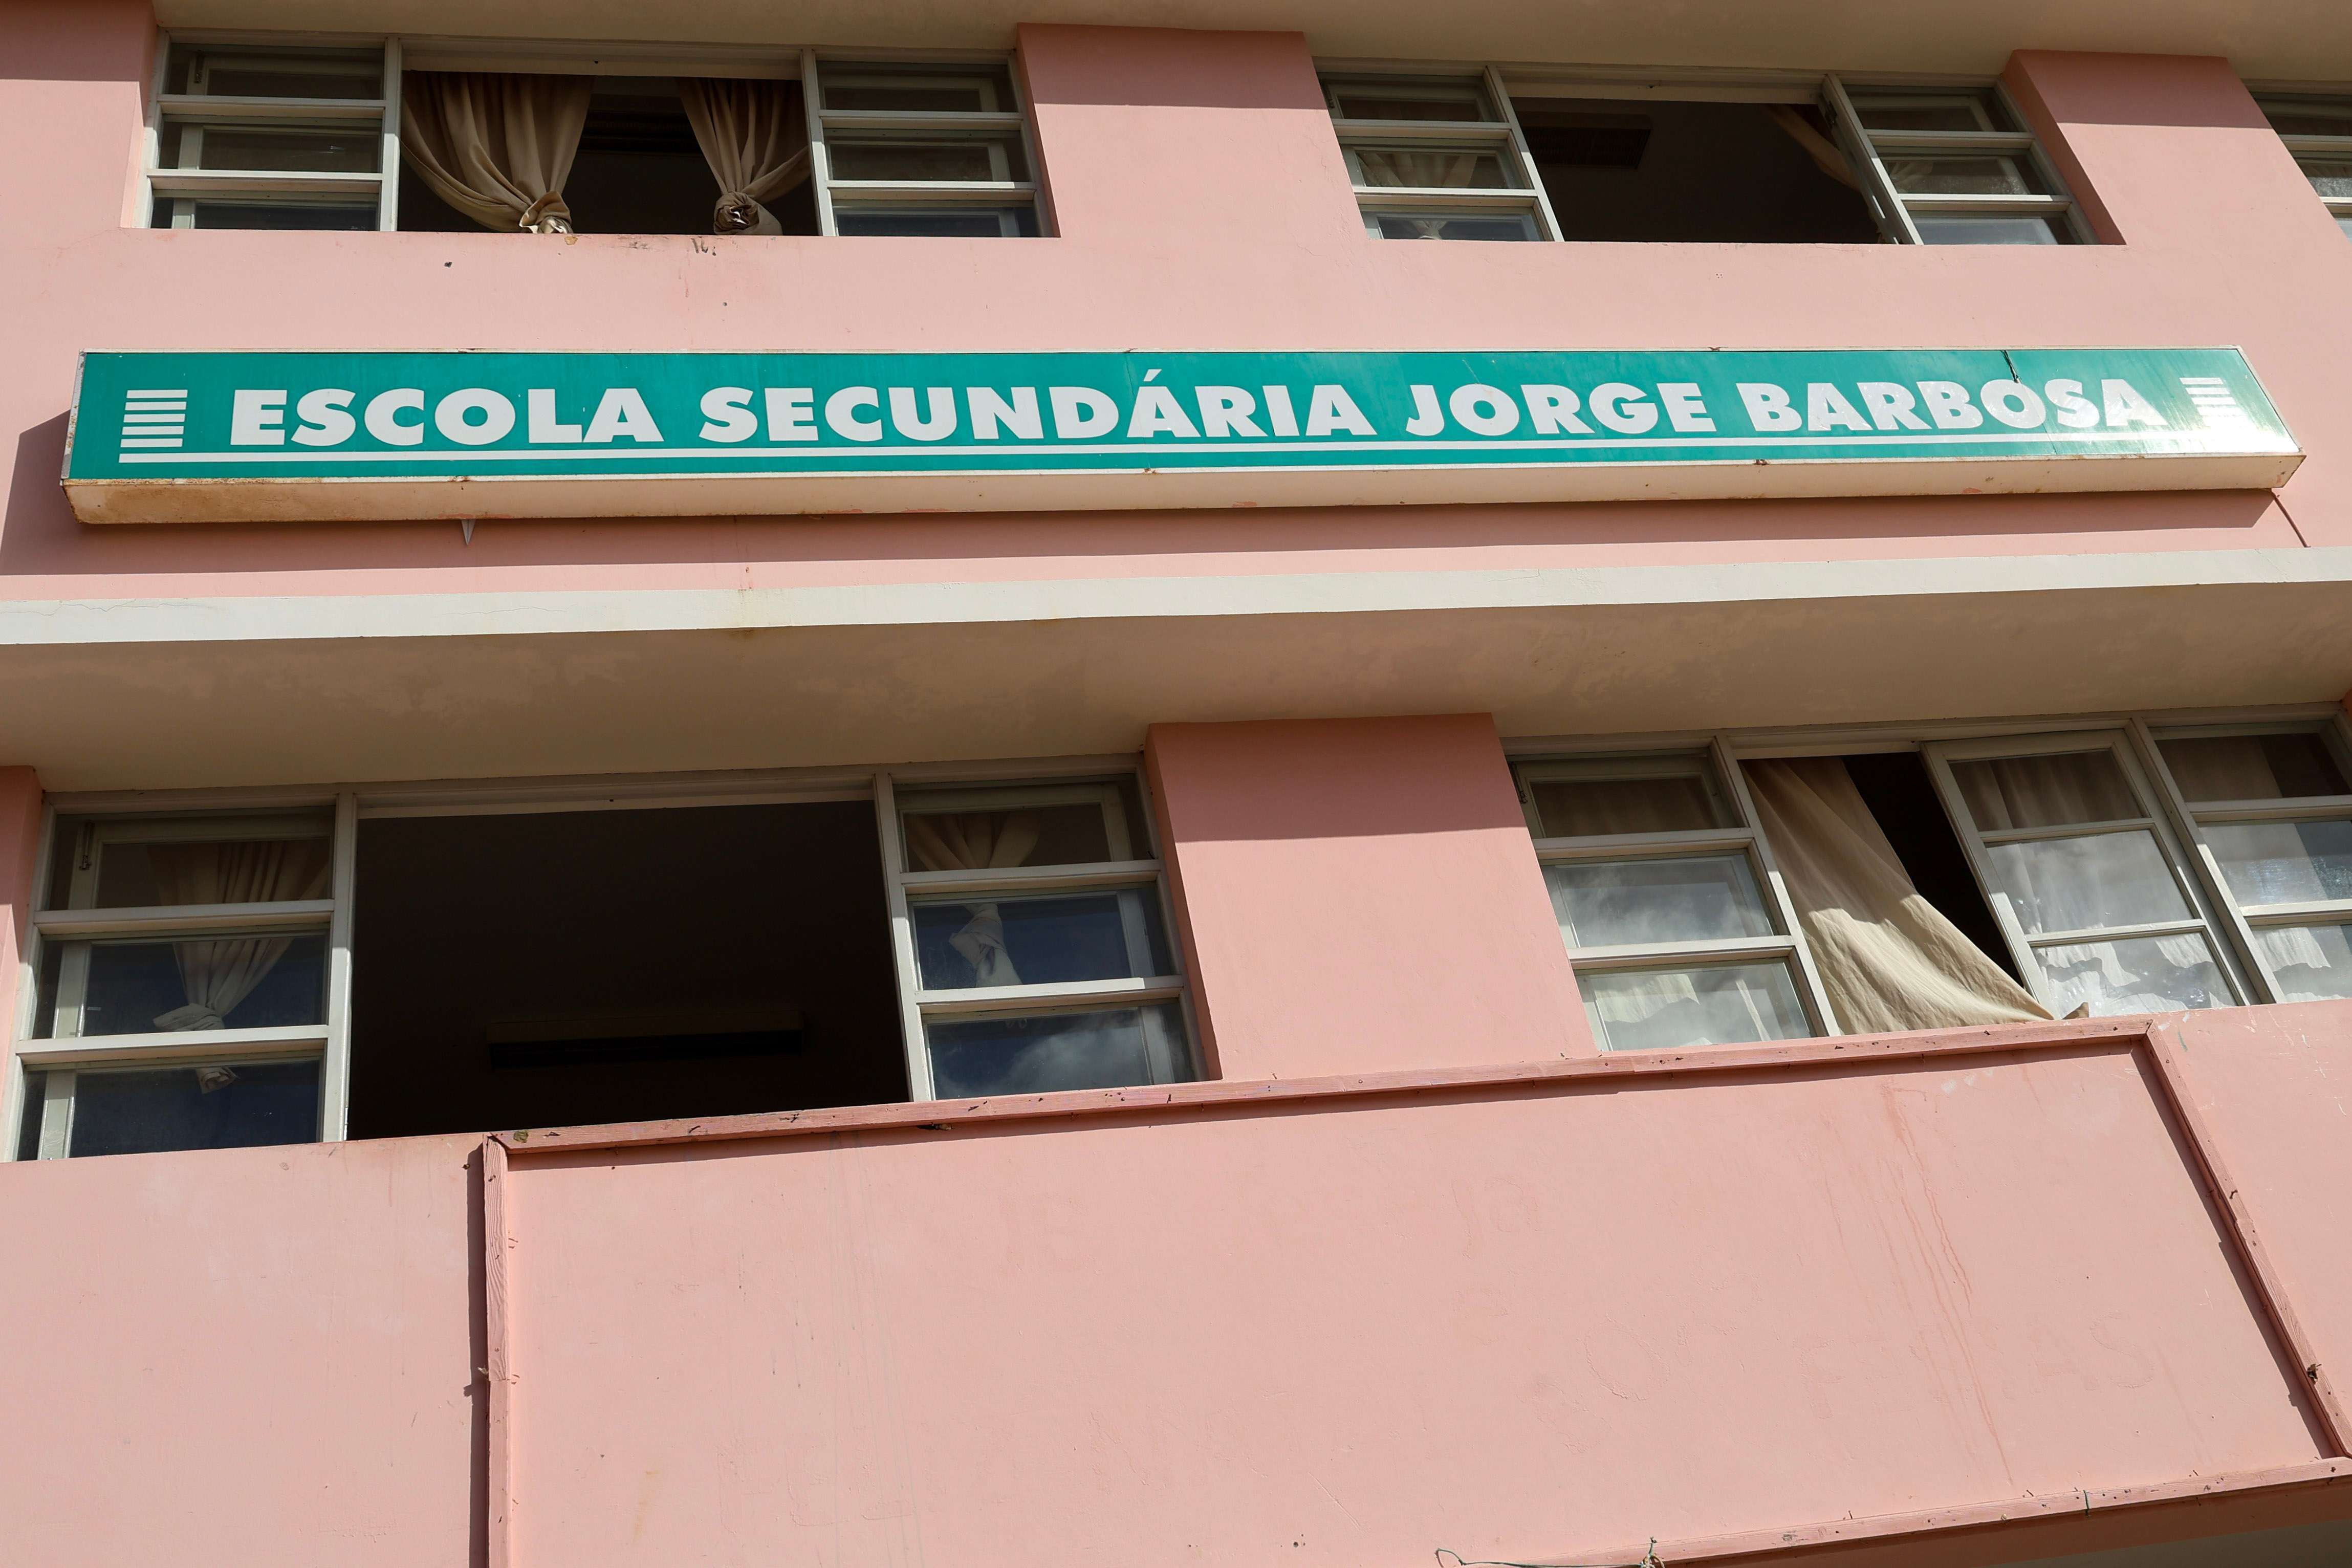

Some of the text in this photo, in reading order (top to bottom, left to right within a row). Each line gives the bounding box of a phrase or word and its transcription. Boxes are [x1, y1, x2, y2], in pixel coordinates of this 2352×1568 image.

[230, 369, 2167, 446] ESCOLA SECUNDÁRIA JORGE BARBOSA
